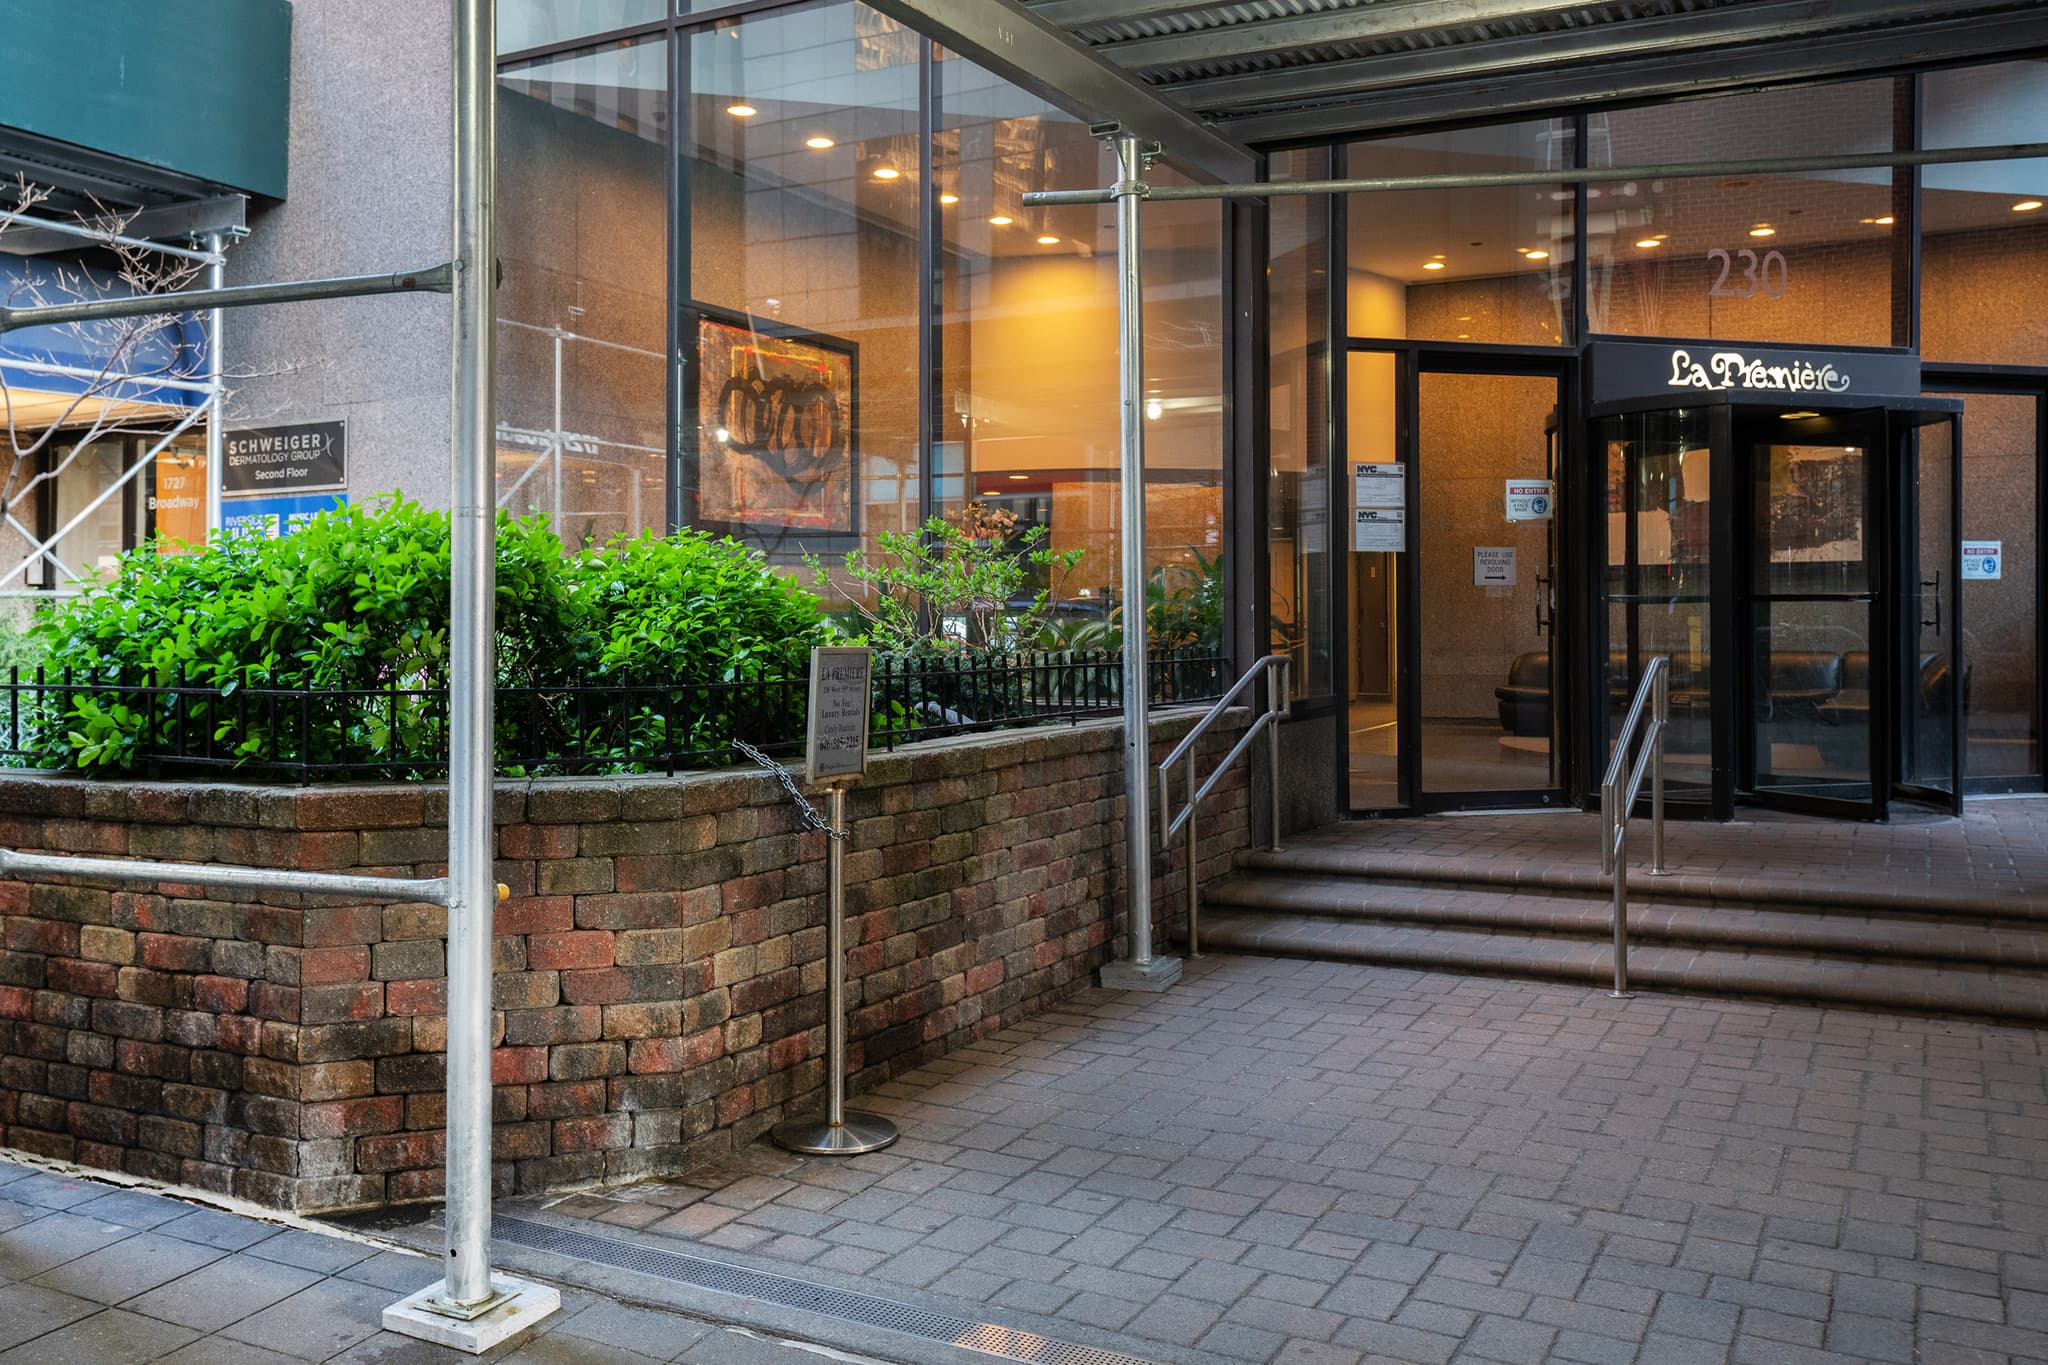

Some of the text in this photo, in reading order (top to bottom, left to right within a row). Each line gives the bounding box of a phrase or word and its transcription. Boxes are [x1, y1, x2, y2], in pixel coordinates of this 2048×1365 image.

[1707, 247, 1788, 299] 230
[1668, 350, 1727, 391] La
[229, 434, 321, 455] SCHWEIGER
[229, 450, 321, 466] DERMATOLOGY GROUP
[255, 467, 309, 480] Second Floor
[1357, 465, 1377, 473] NYC
[163, 475, 186, 490] 1727
[148, 496, 199, 510] Broadway
[1358, 511, 1377, 519] NYC
